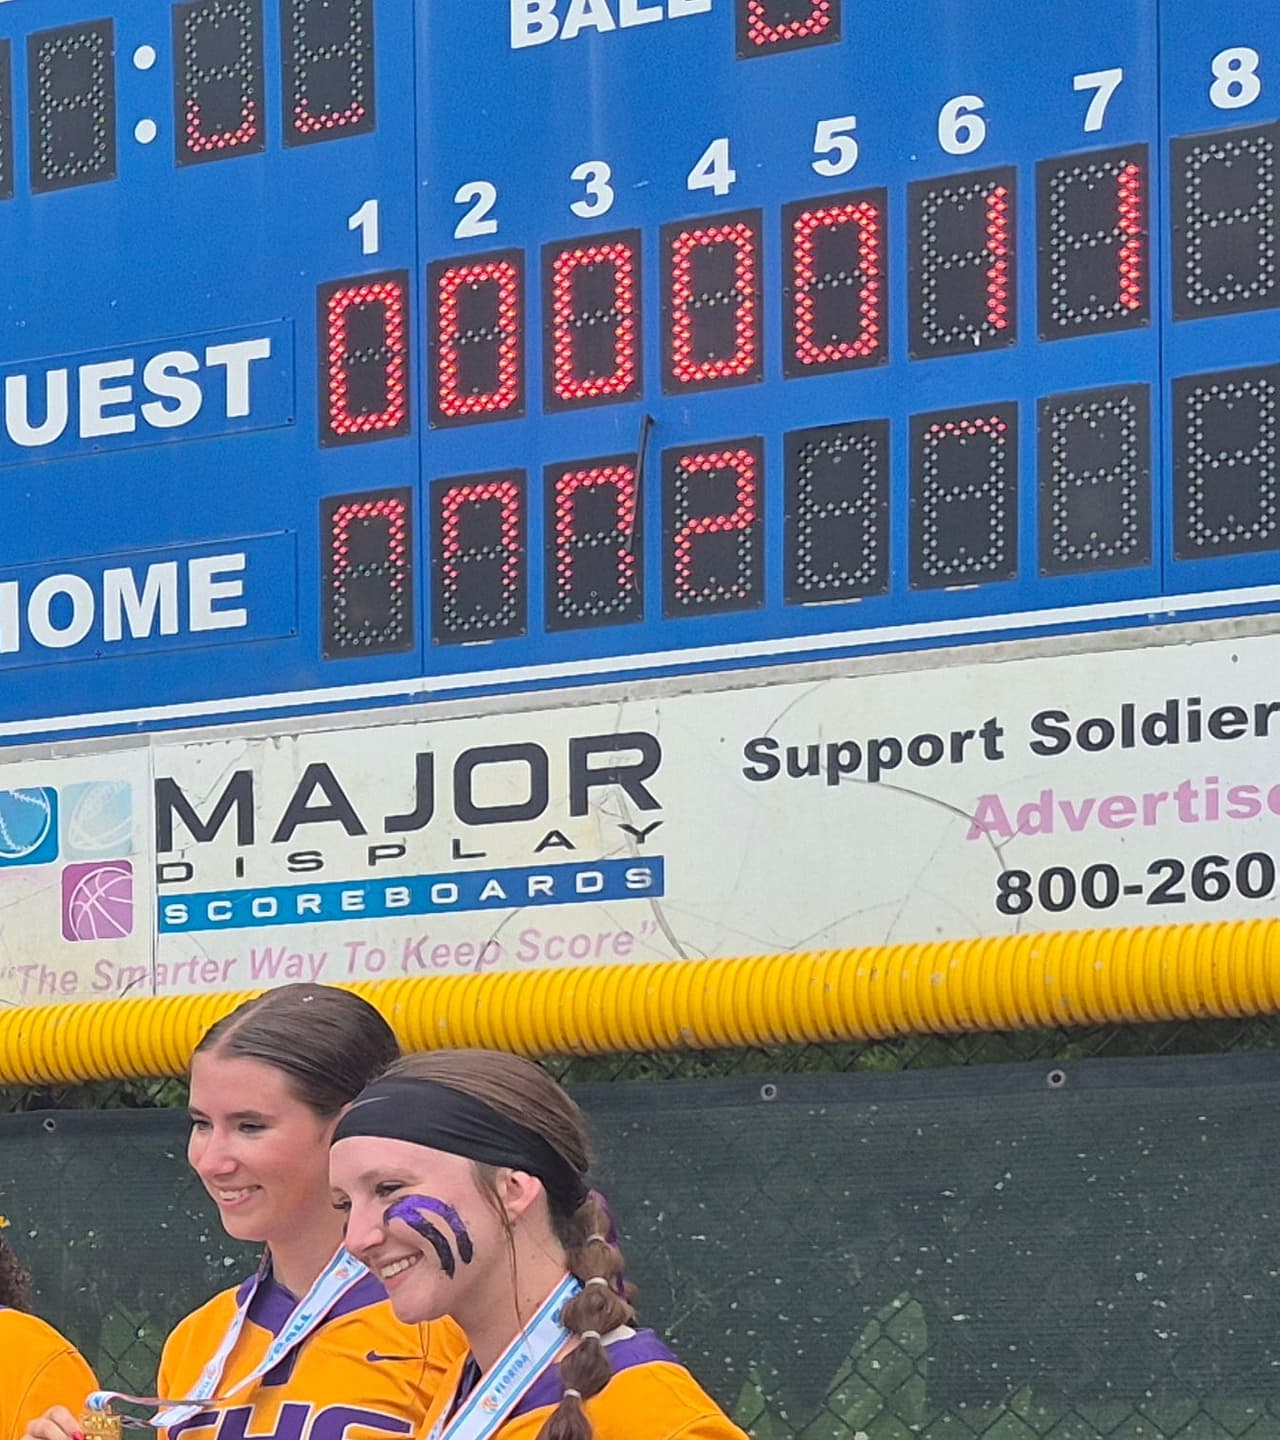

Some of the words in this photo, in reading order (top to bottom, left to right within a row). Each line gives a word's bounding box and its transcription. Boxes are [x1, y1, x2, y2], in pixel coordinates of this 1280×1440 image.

[347, 199, 380, 255] 1
[453, 181, 498, 240] 2
[569, 161, 615, 218] 3
[687, 138, 737, 196] 4
[811, 115, 860, 177] 5
[937, 94, 987, 155] 6
[1072, 68, 1123, 132] 7
[1208, 47, 1262, 109] 8
[327, 281, 403, 434] 0
[438, 260, 517, 417] 0
[552, 242, 633, 400] 0
[671, 222, 755, 382] 0
[792, 202, 880, 364] 0
[985, 185, 1008, 329] 1
[1116, 163, 1141, 310] 1
[742, 716, 1005, 786] Support
[1029, 696, 1280, 757] Soldier
[154, 731, 664, 853] MAJOR
[157, 820, 665, 885] DISPLAY
[994, 851, 1277, 916] 800-260
[164, 866, 654, 926] SCOREBOARDS
[90, 956, 239, 995] Smarter
[248, 944, 328, 983] Way
[343, 940, 387, 974] To
[400, 934, 502, 974] Keep
[495, 1353, 531, 1396] FLORIDA
